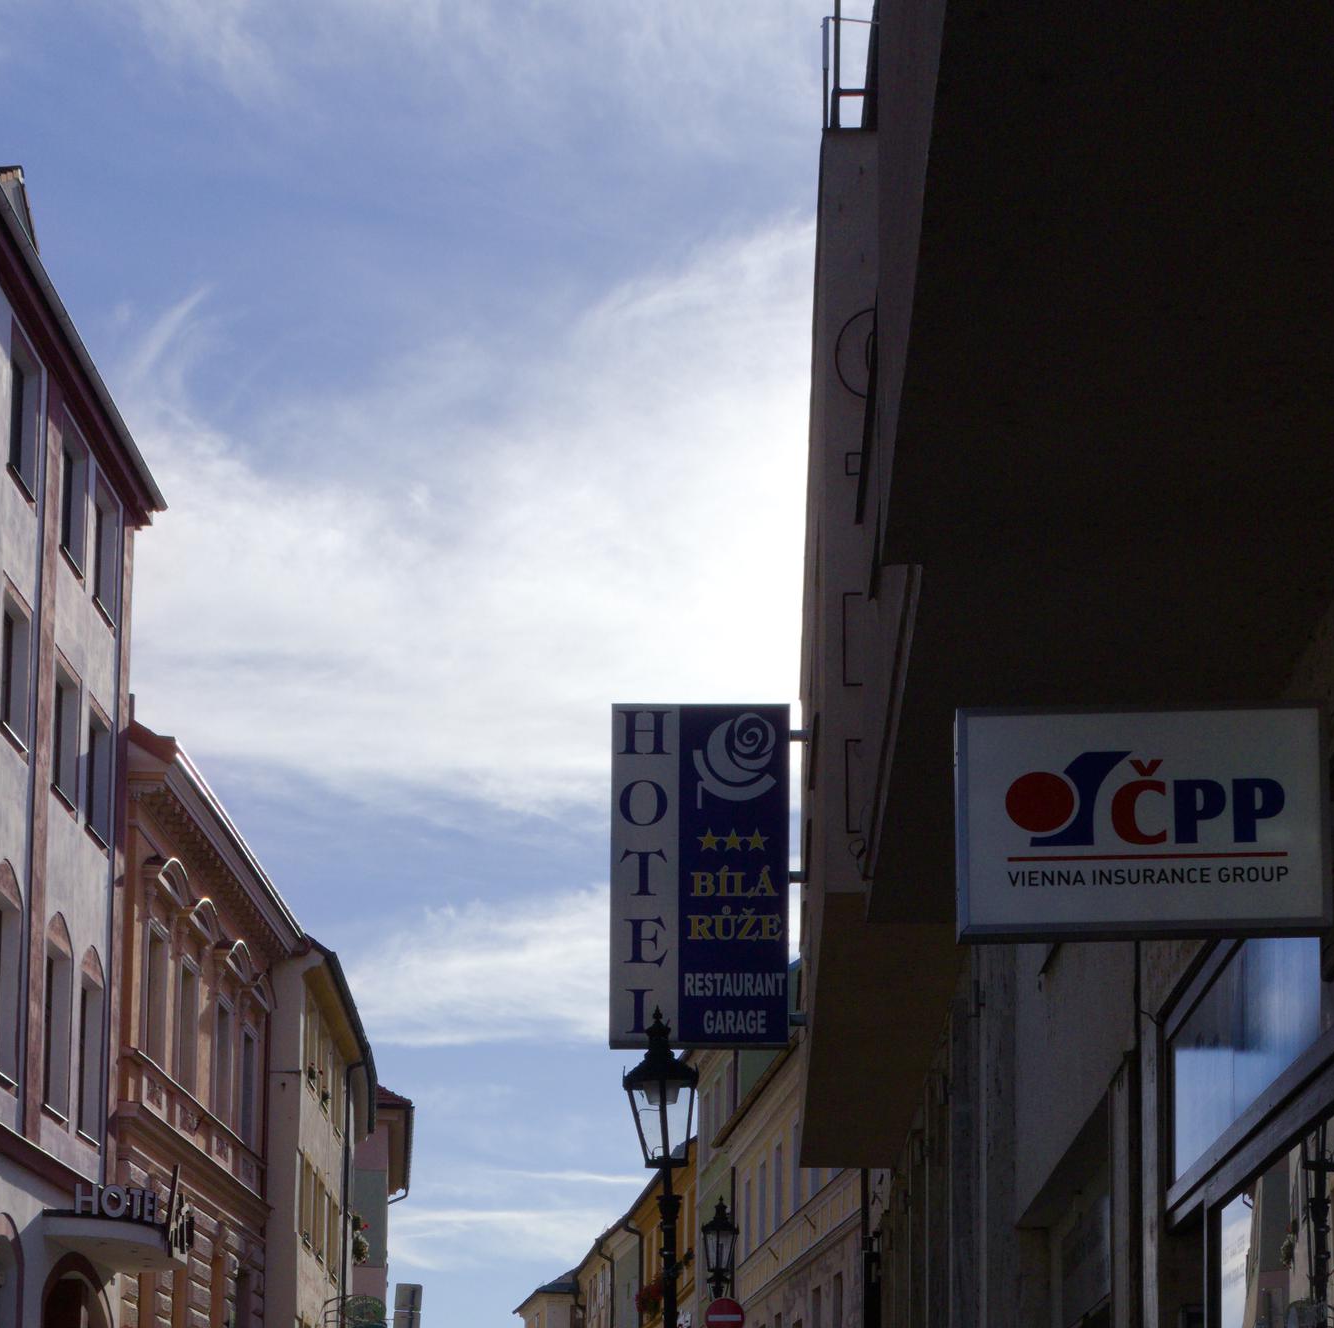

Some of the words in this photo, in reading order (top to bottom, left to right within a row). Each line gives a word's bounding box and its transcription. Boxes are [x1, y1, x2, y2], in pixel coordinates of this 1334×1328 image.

[1111, 759, 1285, 846] ČPP
[689, 865, 779, 897] BÍLÁ
[1007, 868, 1086, 888] VIENNA
[1092, 867, 1211, 887] INSURANCE
[1218, 865, 1289, 884] GROUP
[686, 905, 783, 942] RŮŽE
[683, 971, 786, 998] RESTAURANT
[702, 1008, 767, 1035] GARAGE
[74, 1182, 164, 1225] HOTEL
